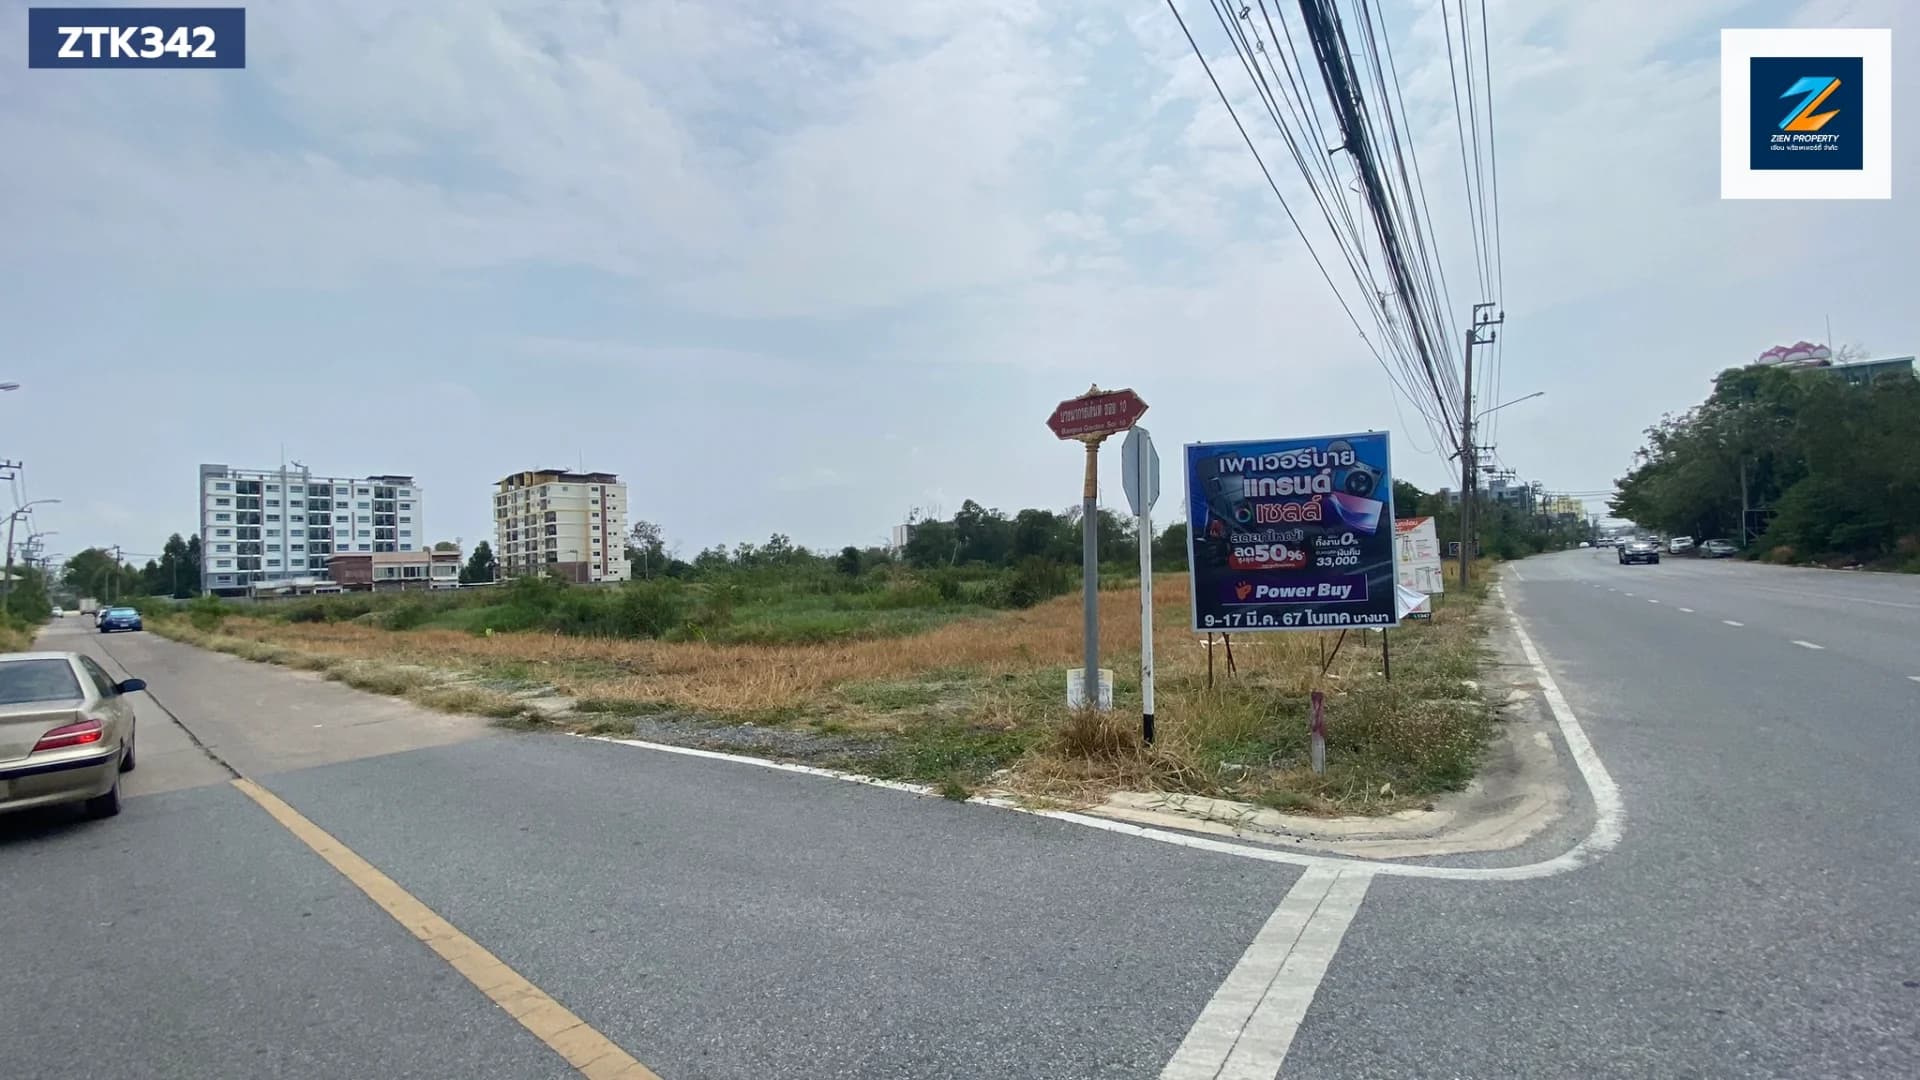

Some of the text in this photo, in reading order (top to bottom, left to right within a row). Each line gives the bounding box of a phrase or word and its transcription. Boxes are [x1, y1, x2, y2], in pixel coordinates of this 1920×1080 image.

[1220, 447, 1355, 473] เพาเวอร์บาย
[1243, 468, 1331, 497] แกรนด์
[1256, 494, 1322, 523] เซลล์
[1234, 546, 1255, 557] ลด
[1316, 555, 1358, 568] 33,000
[1255, 583, 1352, 600] Power Buy
[1246, 611, 1279, 627] มี.ค.
[1282, 612, 1303, 625] 67
[1304, 609, 1351, 625] ไบเทค
[1353, 613, 1389, 623] บางนา
